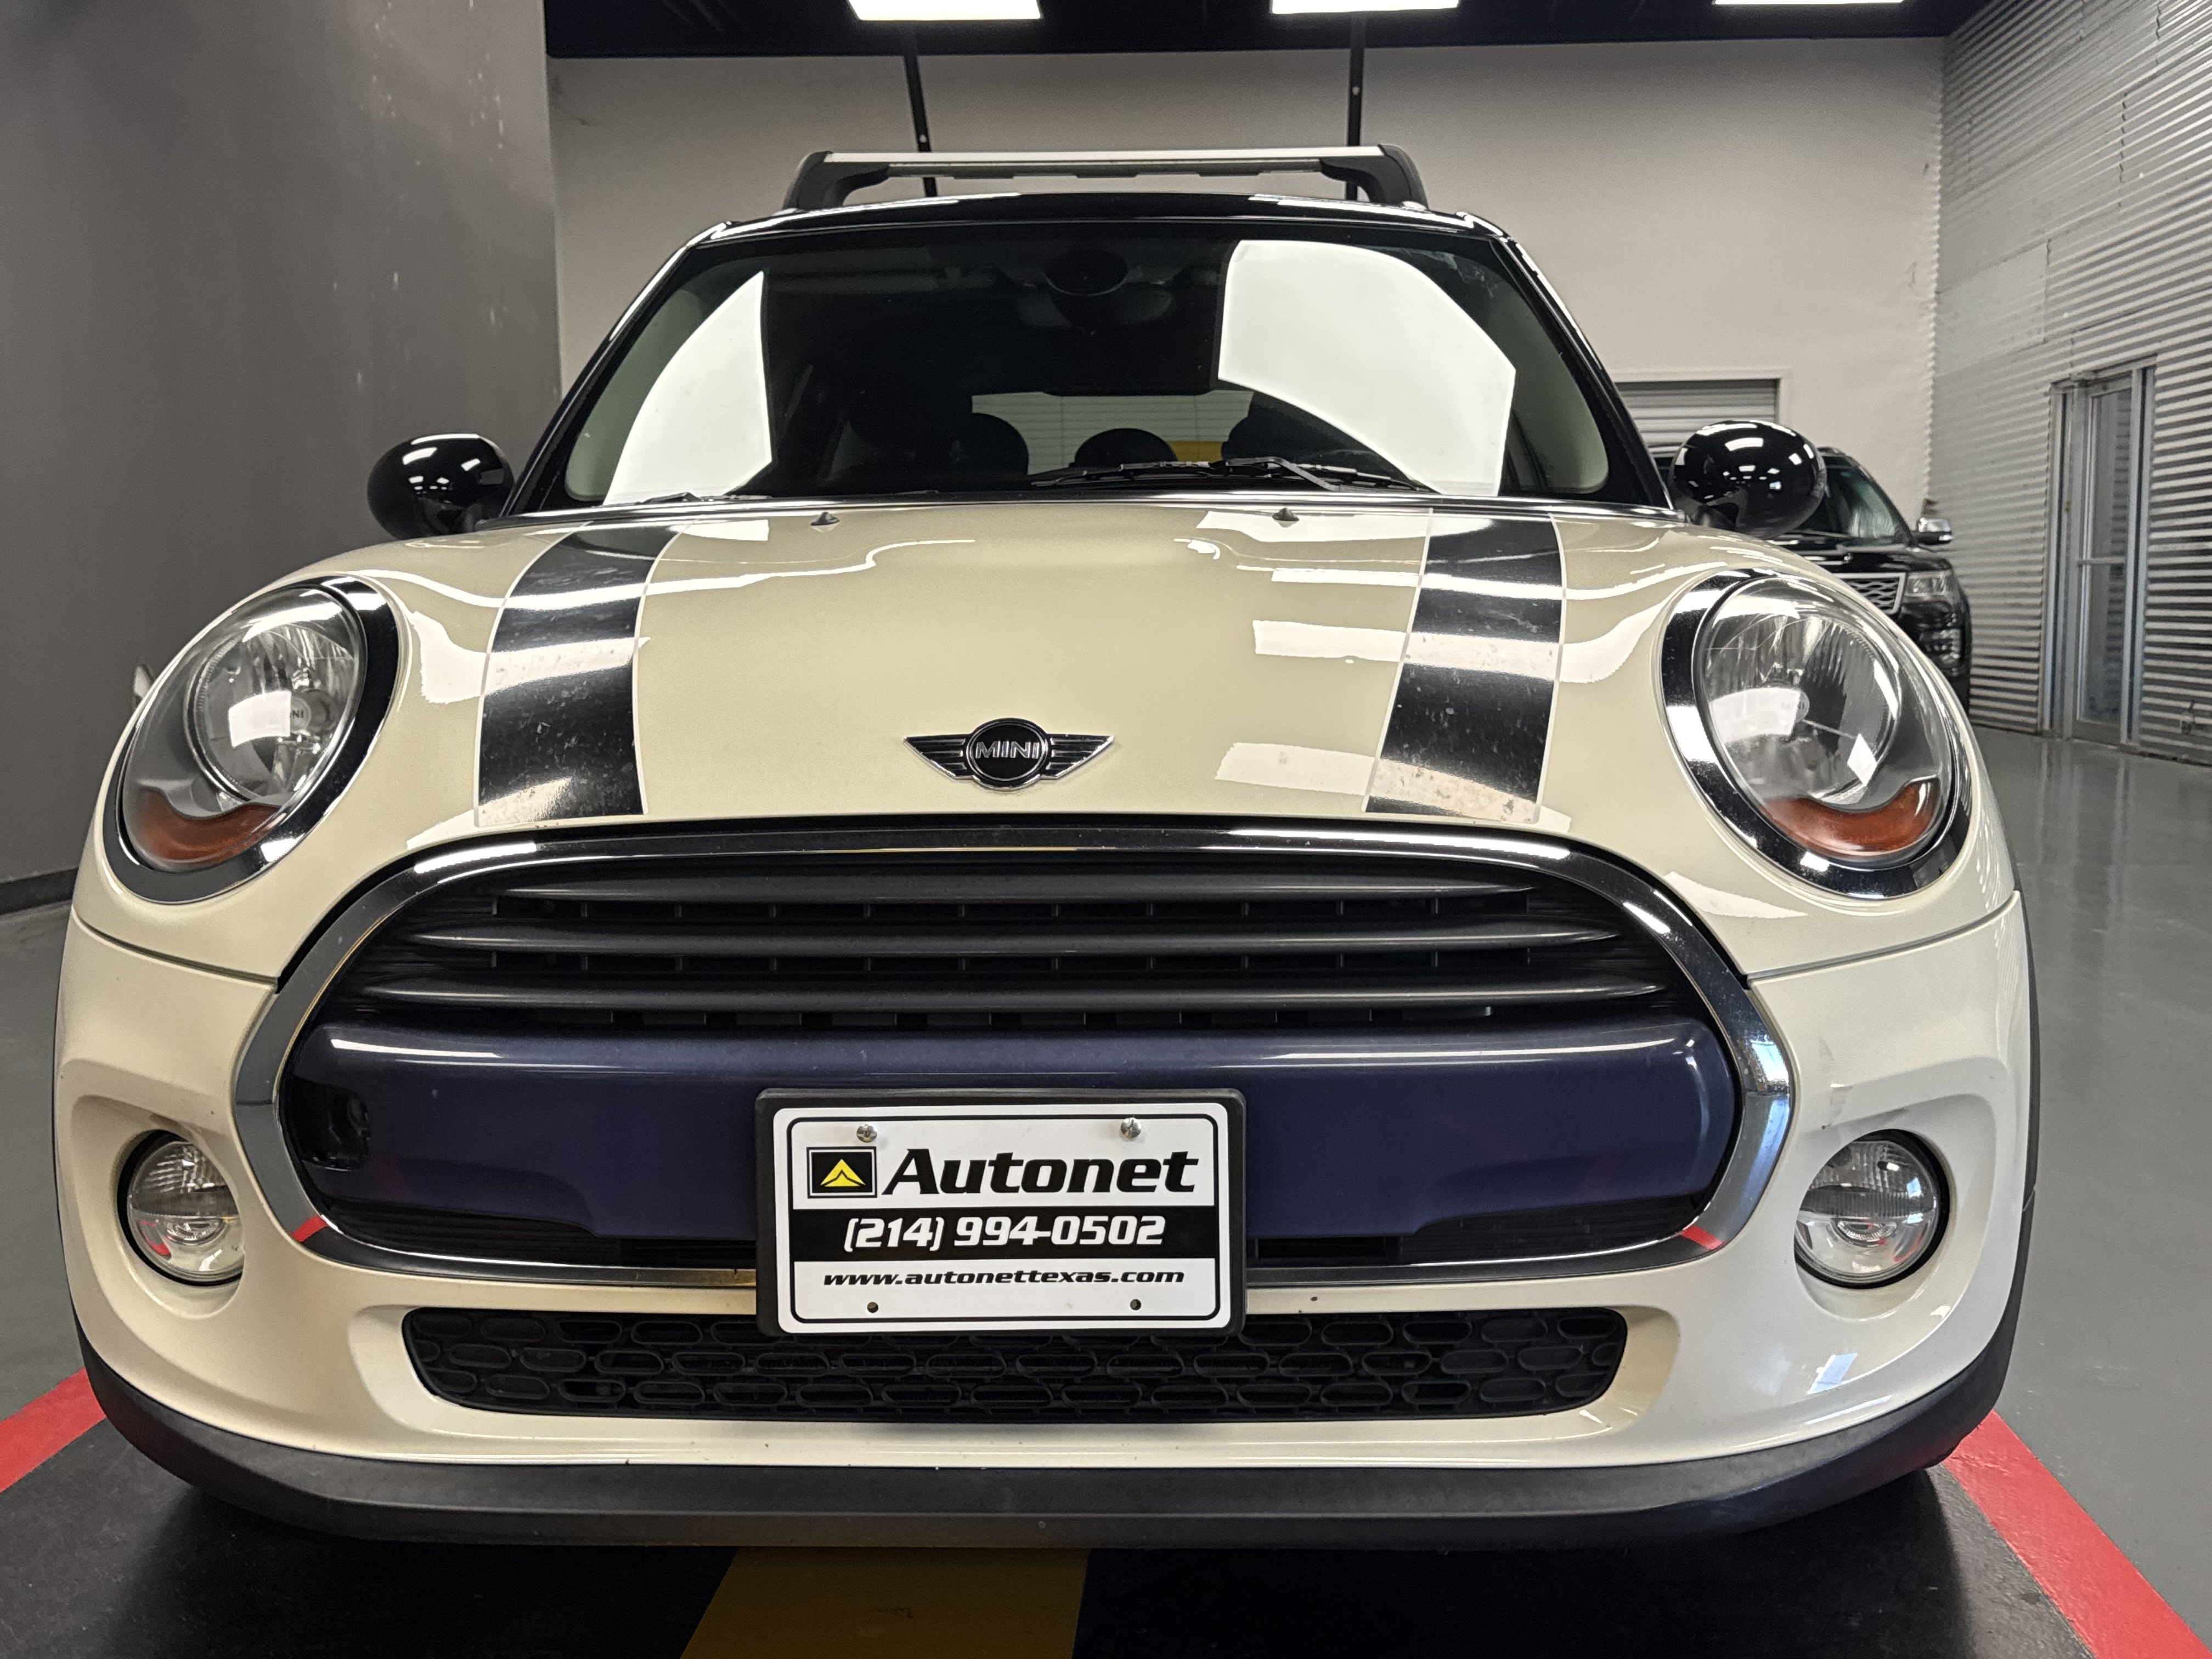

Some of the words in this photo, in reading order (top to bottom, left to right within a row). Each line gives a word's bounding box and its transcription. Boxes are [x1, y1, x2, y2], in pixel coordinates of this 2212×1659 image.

[975, 741, 1040, 759] MINI
[881, 1148, 1200, 1195] Autonet
[844, 1217, 944, 1252] (214)
[954, 1216, 1166, 1246] 994-0502
[824, 1269, 1185, 1286] www.autonettexas.com
